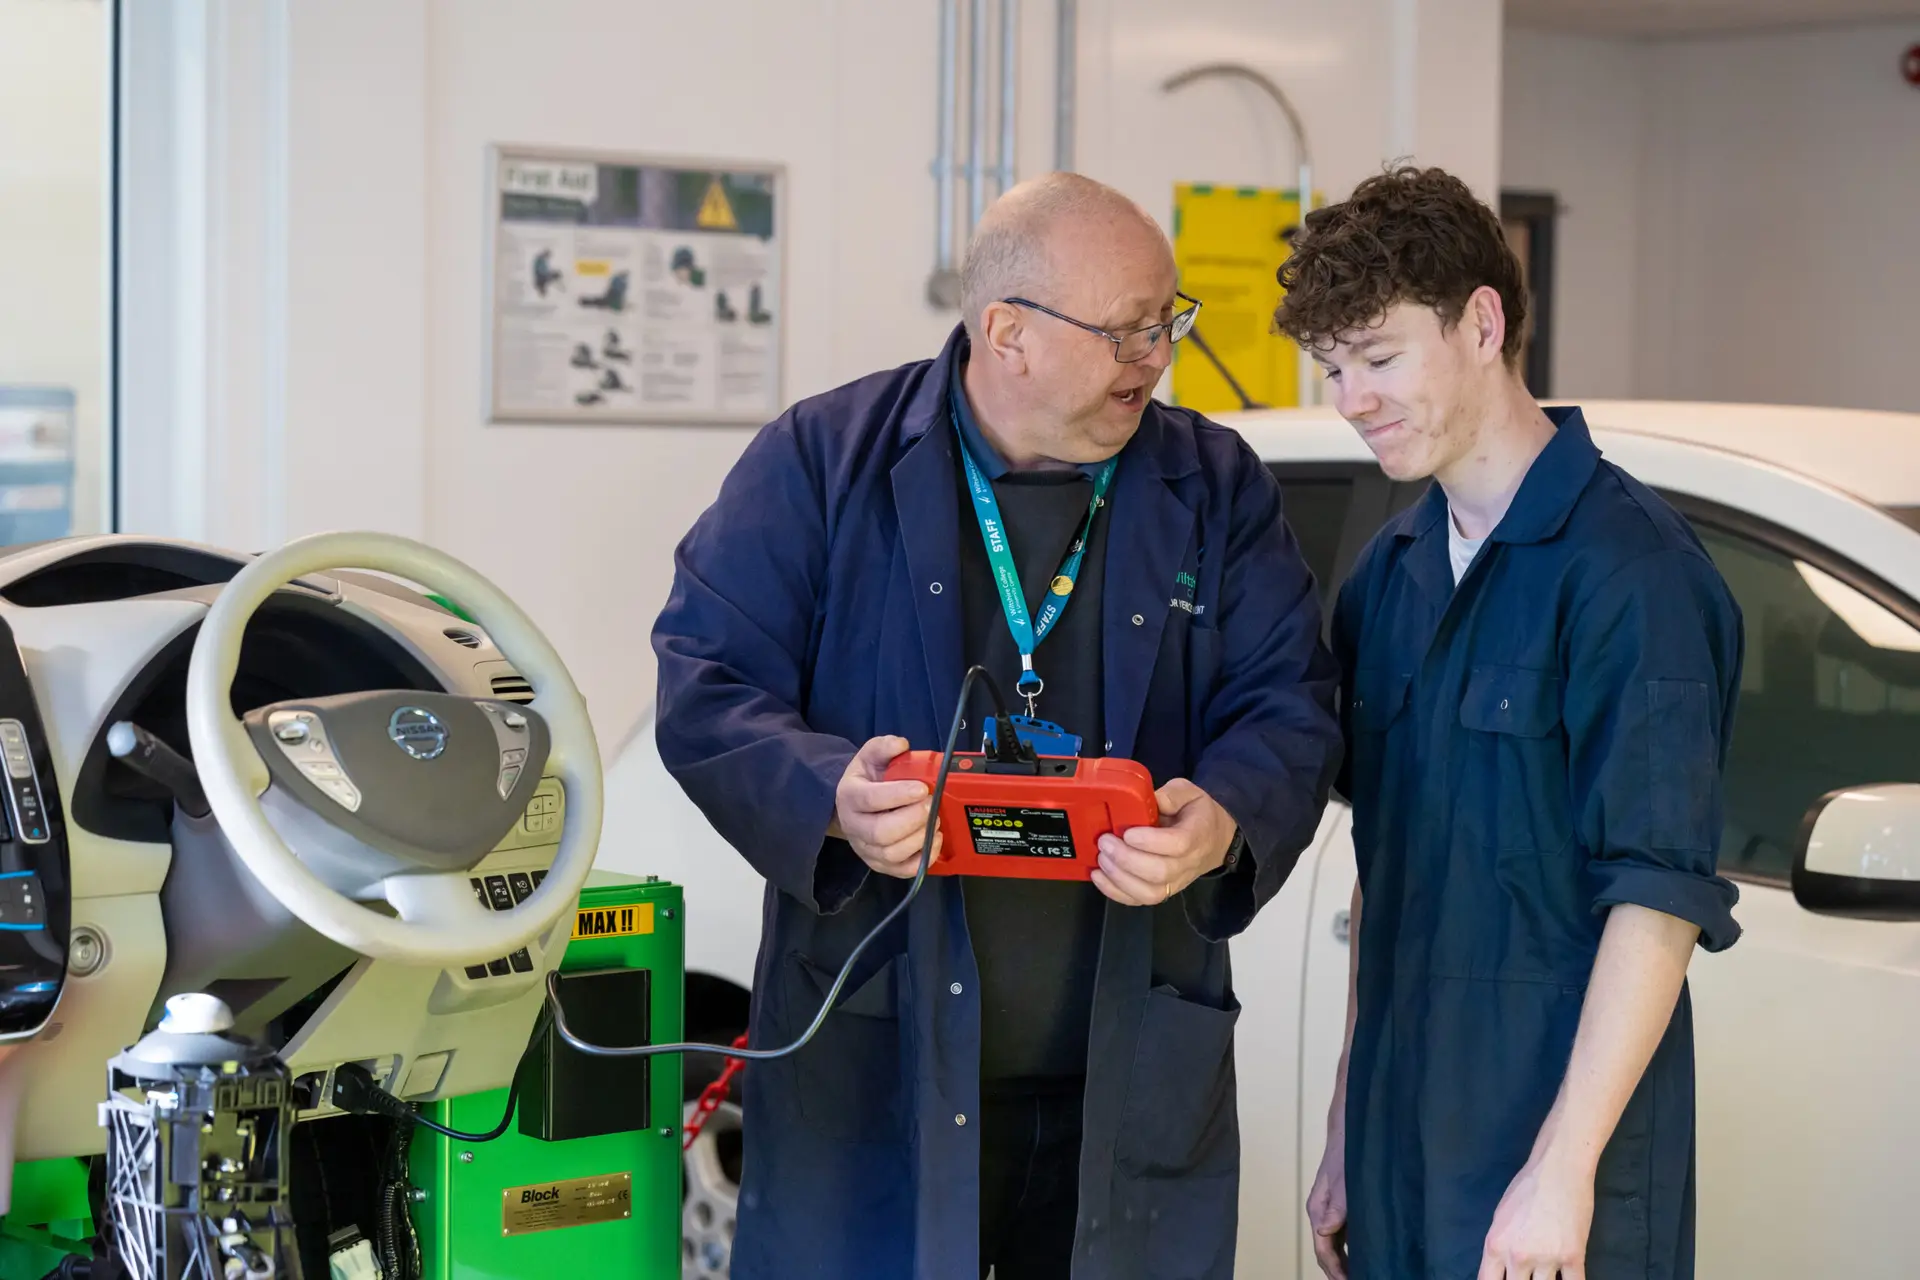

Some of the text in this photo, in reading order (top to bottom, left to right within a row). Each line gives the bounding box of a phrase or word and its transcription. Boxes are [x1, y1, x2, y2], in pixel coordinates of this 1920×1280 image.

[985, 519, 1004, 552] STAFF
[999, 565, 1016, 617] Wiltshire College
[1036, 604, 1056, 637] STAFF
[579, 910, 617, 936] MAX
[521, 1186, 559, 1203] Block
